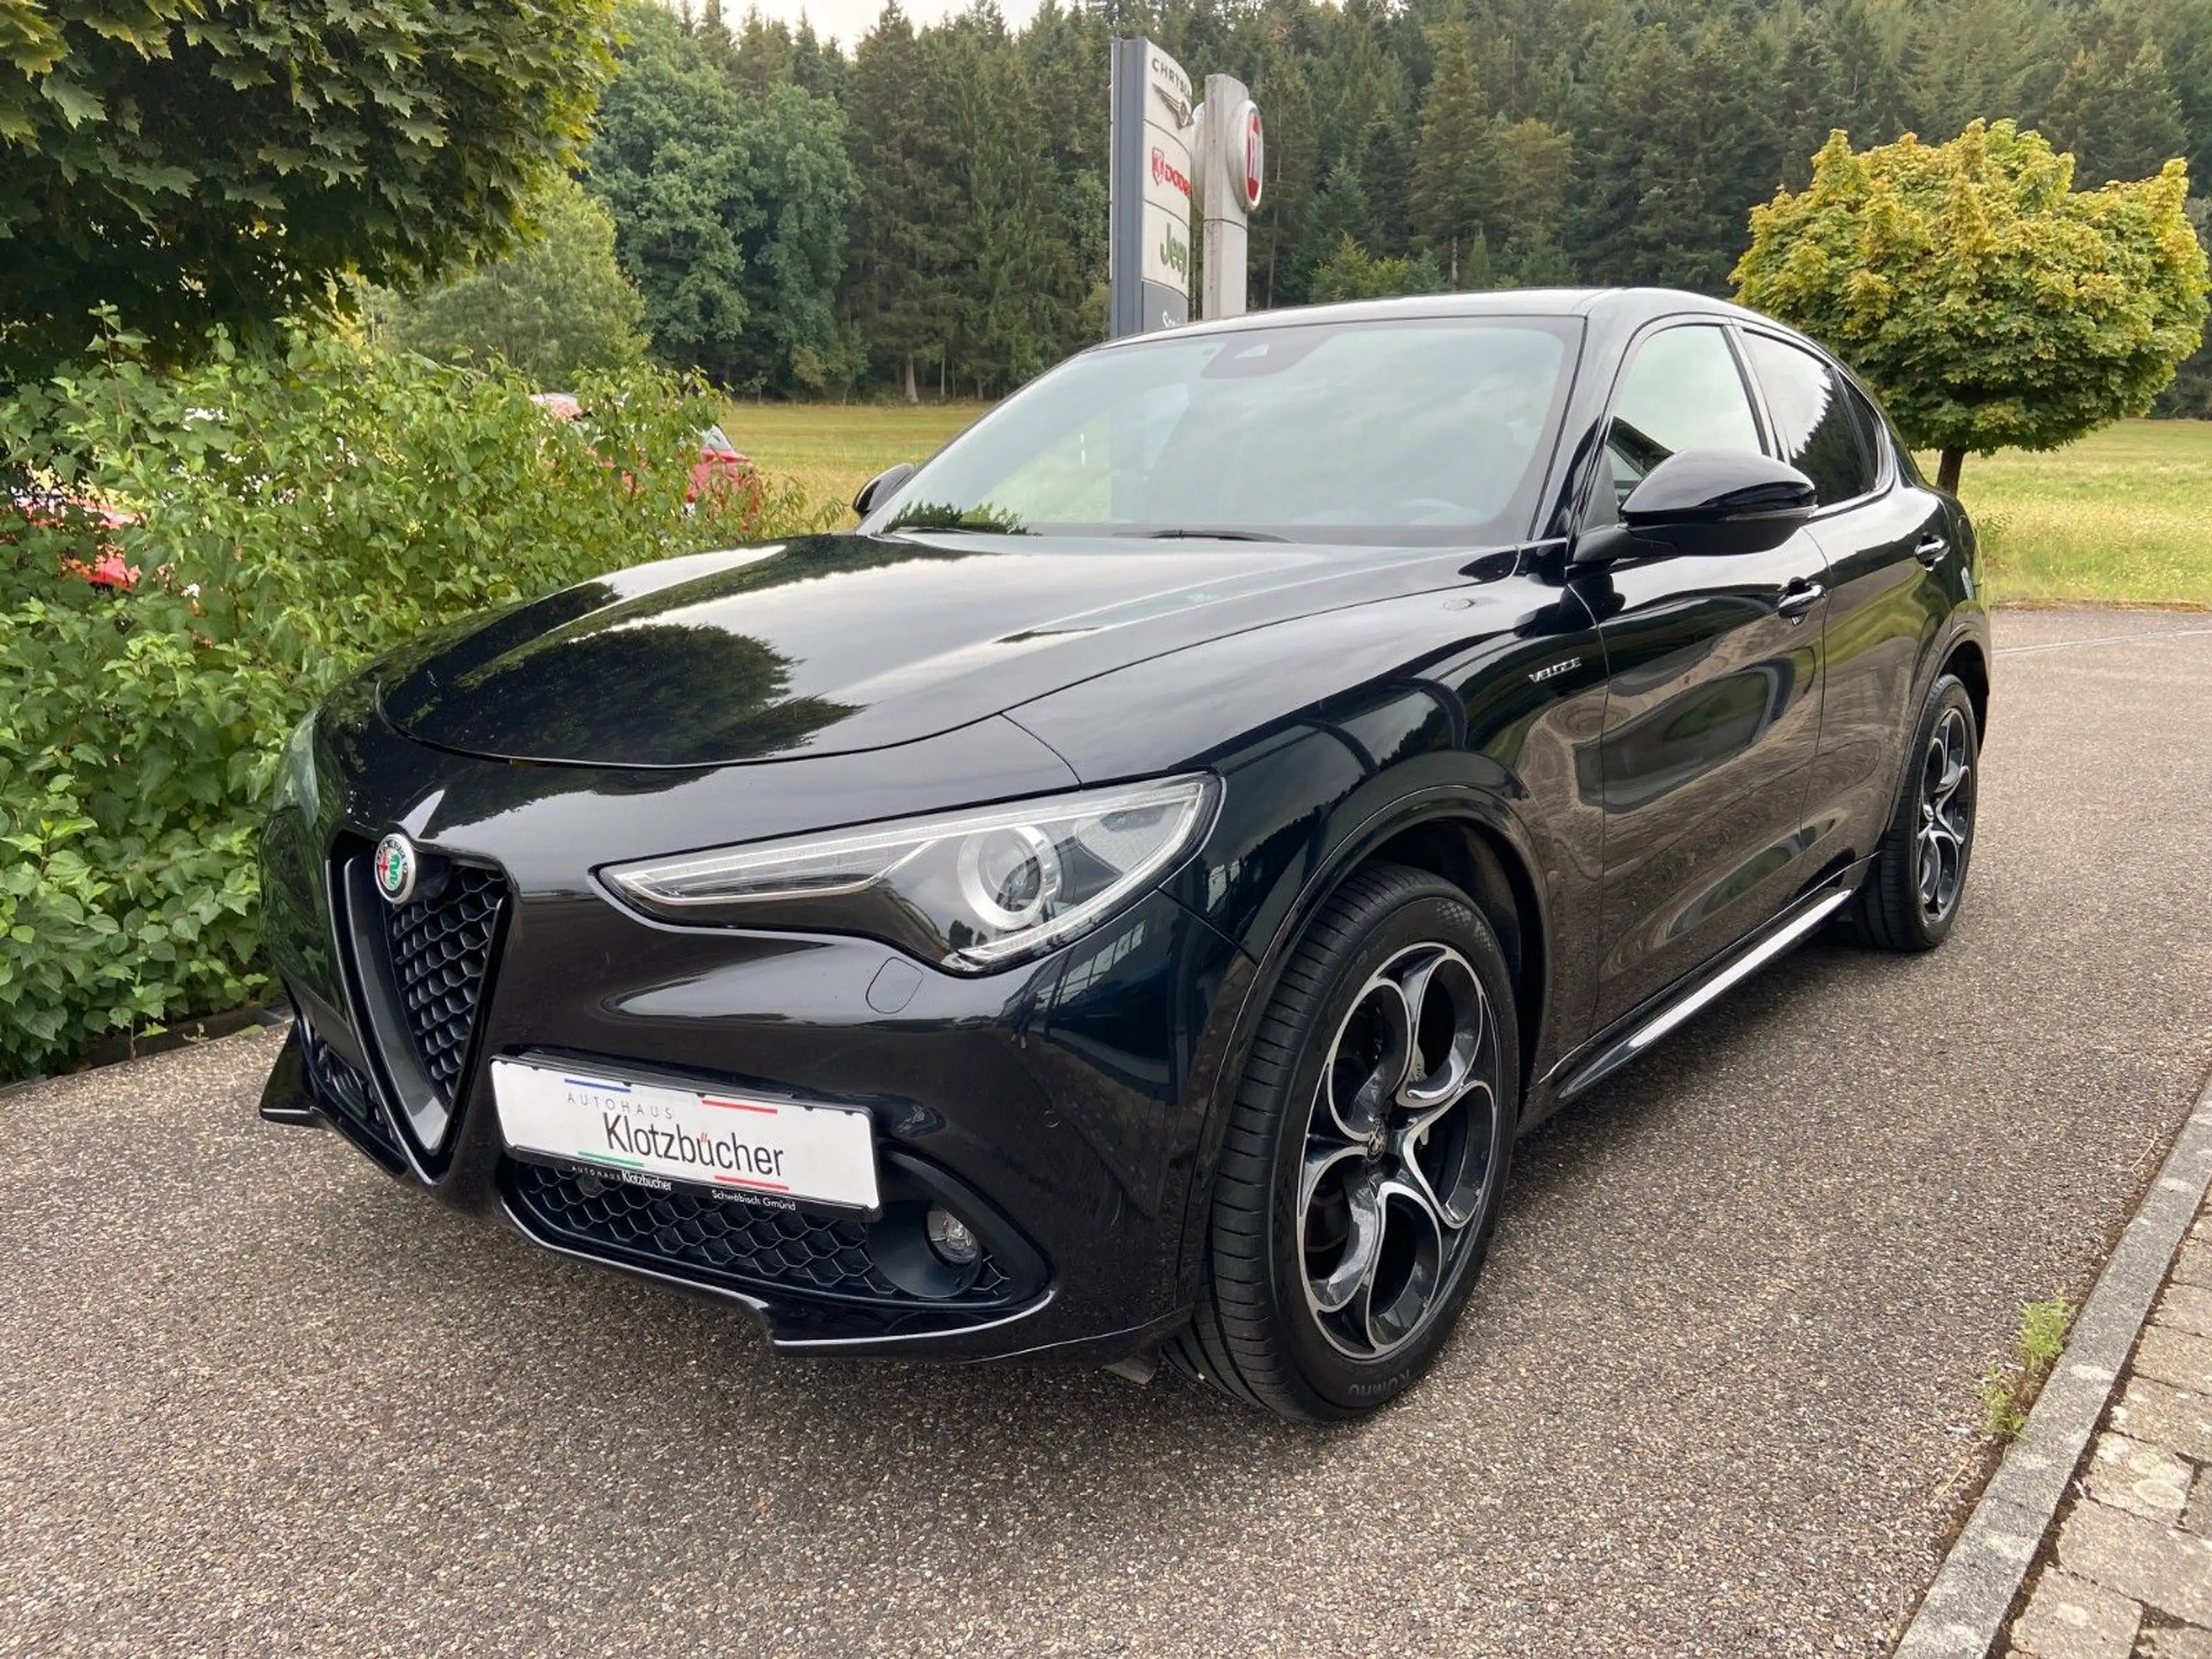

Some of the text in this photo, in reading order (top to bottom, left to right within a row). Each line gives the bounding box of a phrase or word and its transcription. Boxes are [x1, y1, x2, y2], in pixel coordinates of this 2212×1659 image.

[1152, 58, 1191, 98] CHRYSL
[1160, 222, 1187, 284] Jeep
[1528, 657, 1582, 684] VELOCE
[568, 1093, 673, 1119] AUTOHAUS
[603, 1111, 784, 1177] Klotzbücher
[571, 1165, 622, 1181] AUTOHAUS
